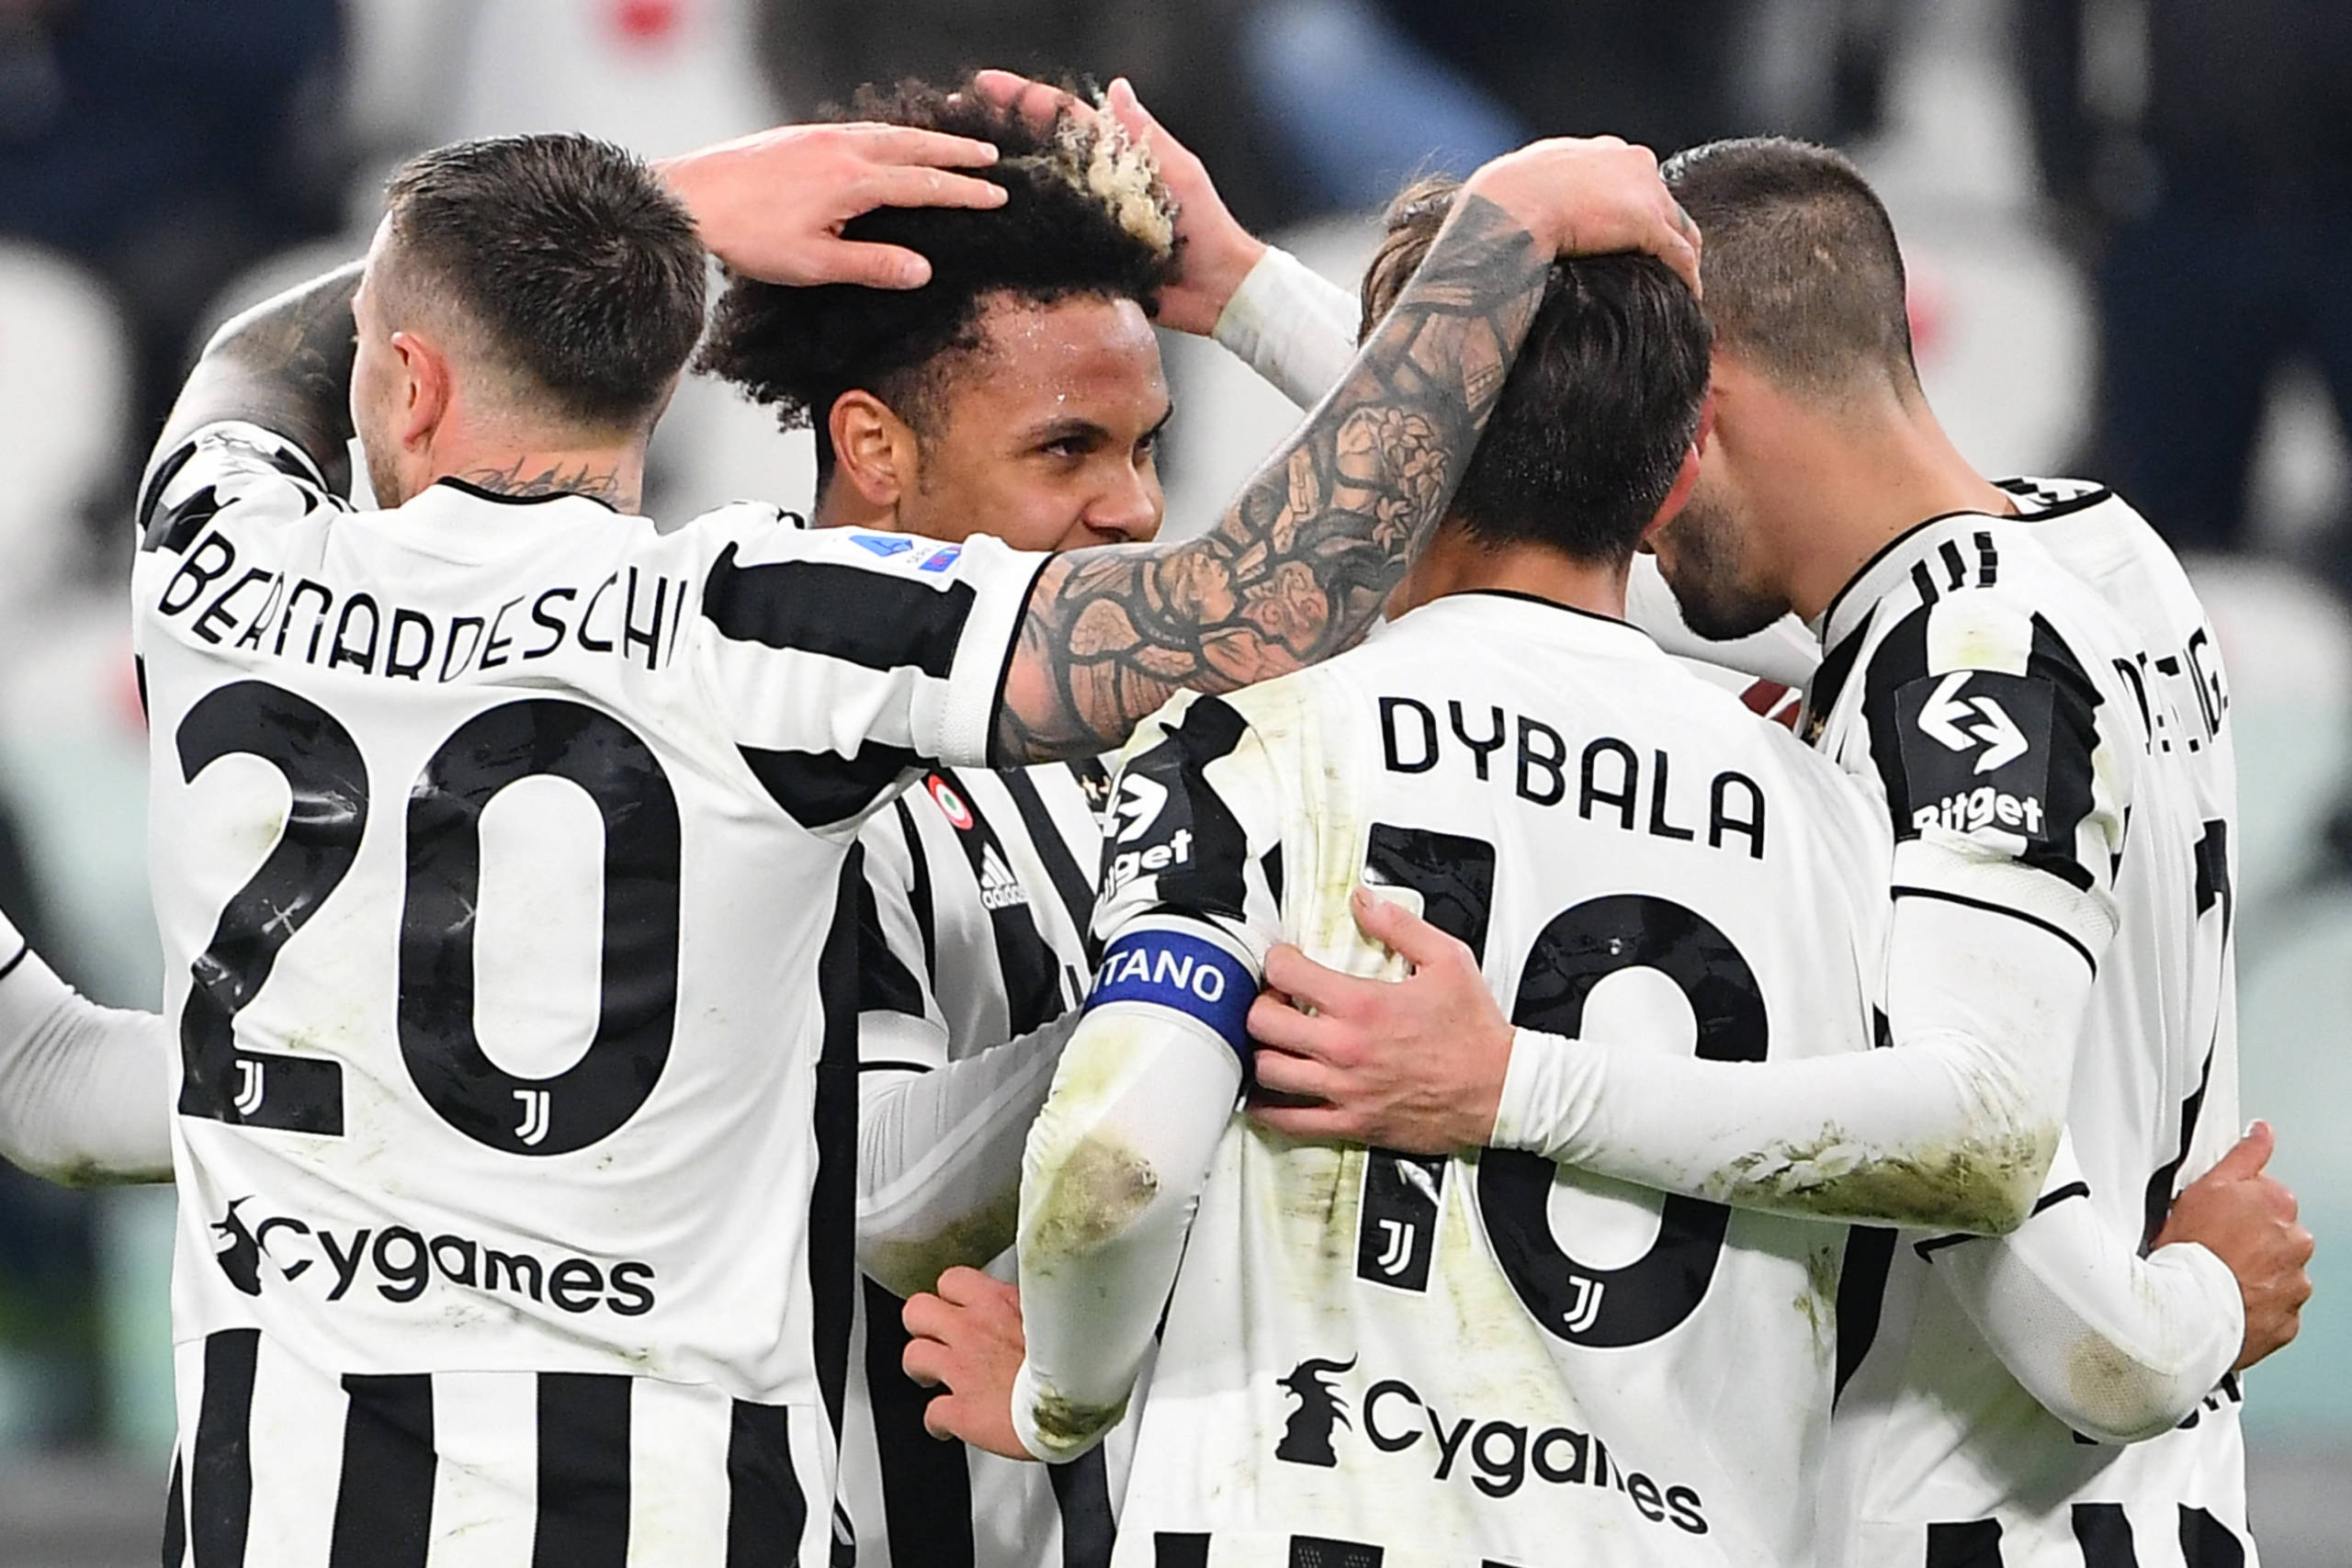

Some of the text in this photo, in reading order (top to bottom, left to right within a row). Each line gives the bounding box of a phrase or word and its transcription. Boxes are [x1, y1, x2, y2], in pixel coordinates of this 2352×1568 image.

[1379, 696, 1766, 860] DYBALA
[1913, 786, 2043, 833] Bitget
[176, 679, 681, 1156] 20
[1356, 822, 1770, 1348] 10
[255, 1217, 655, 1316] Cygames
